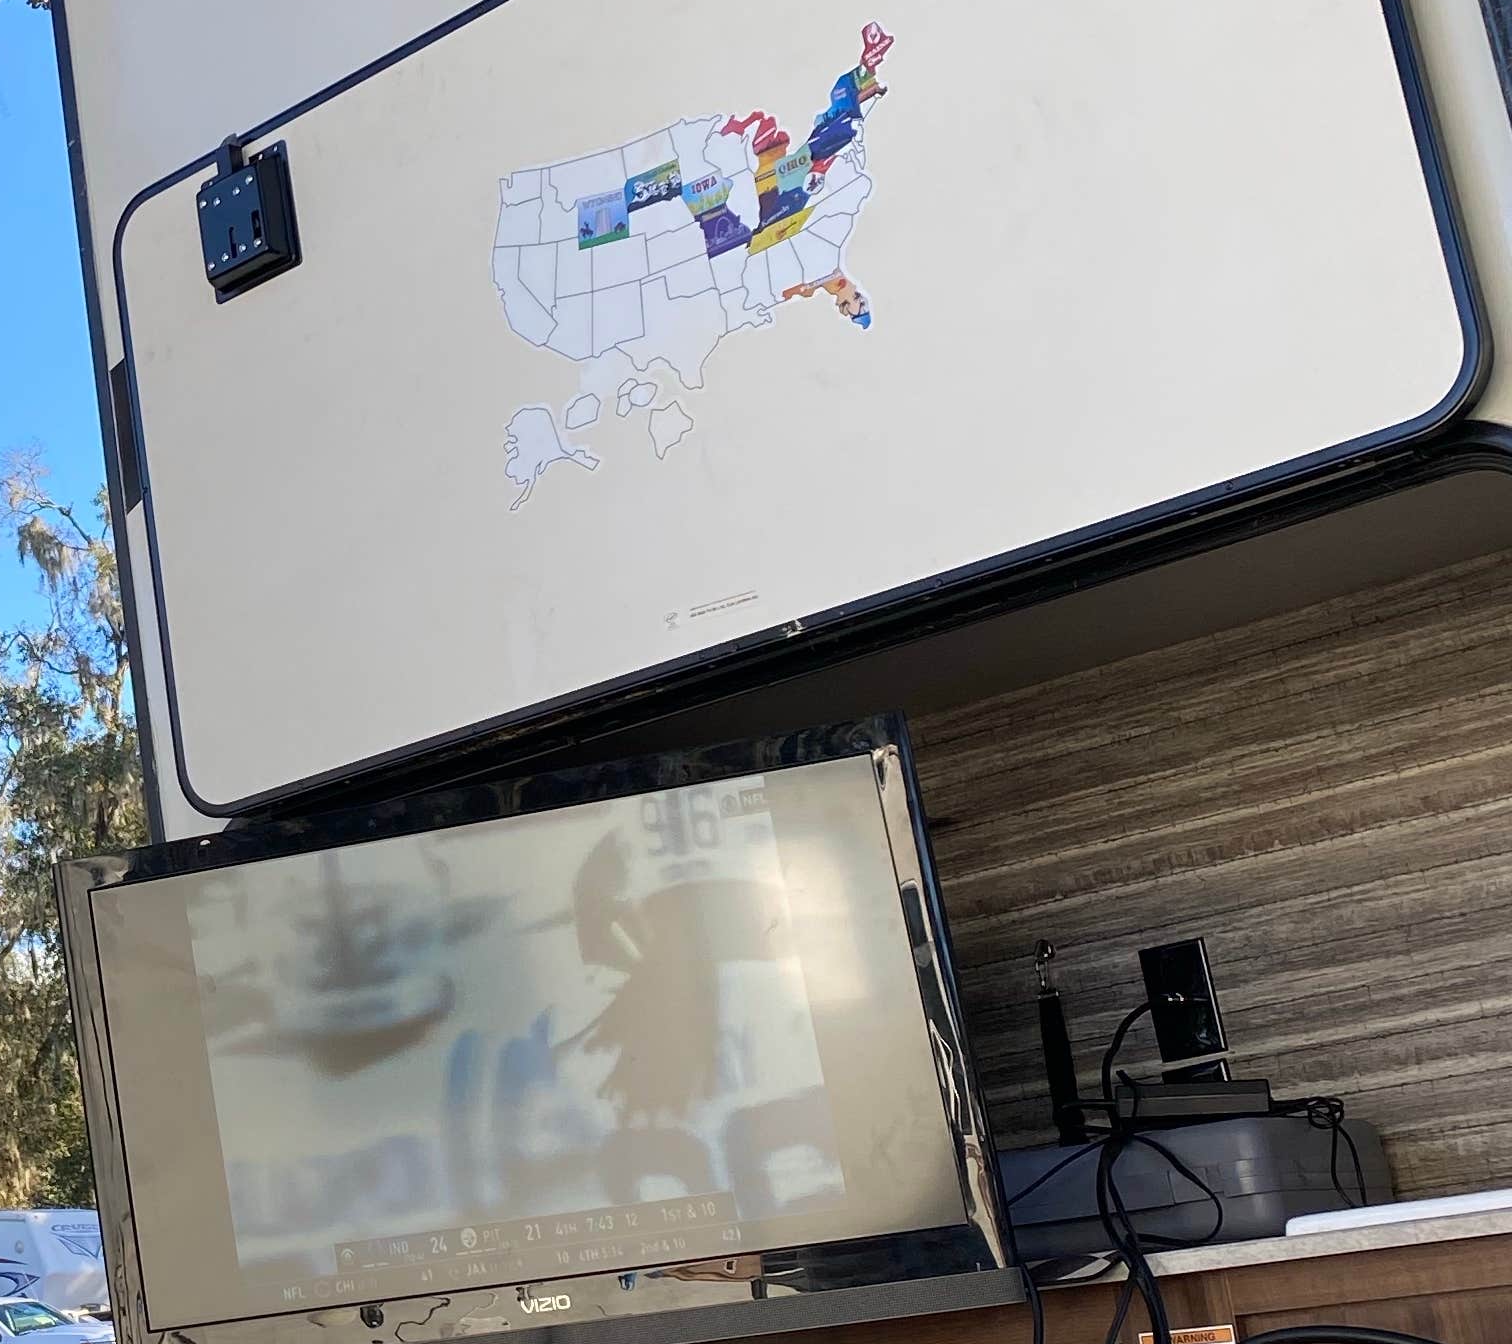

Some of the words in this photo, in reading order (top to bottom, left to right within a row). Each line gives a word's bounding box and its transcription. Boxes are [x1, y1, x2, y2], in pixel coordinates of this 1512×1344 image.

[691, 175, 717, 194] IOWA
[388, 1240, 409, 1256] IND
[429, 1235, 448, 1254] 24
[482, 1228, 501, 1243] PIT
[524, 1223, 542, 1241] 21
[624, 1212, 640, 1227] 12
[701, 1201, 717, 1217] 10
[520, 1294, 571, 1314] VIZIO
